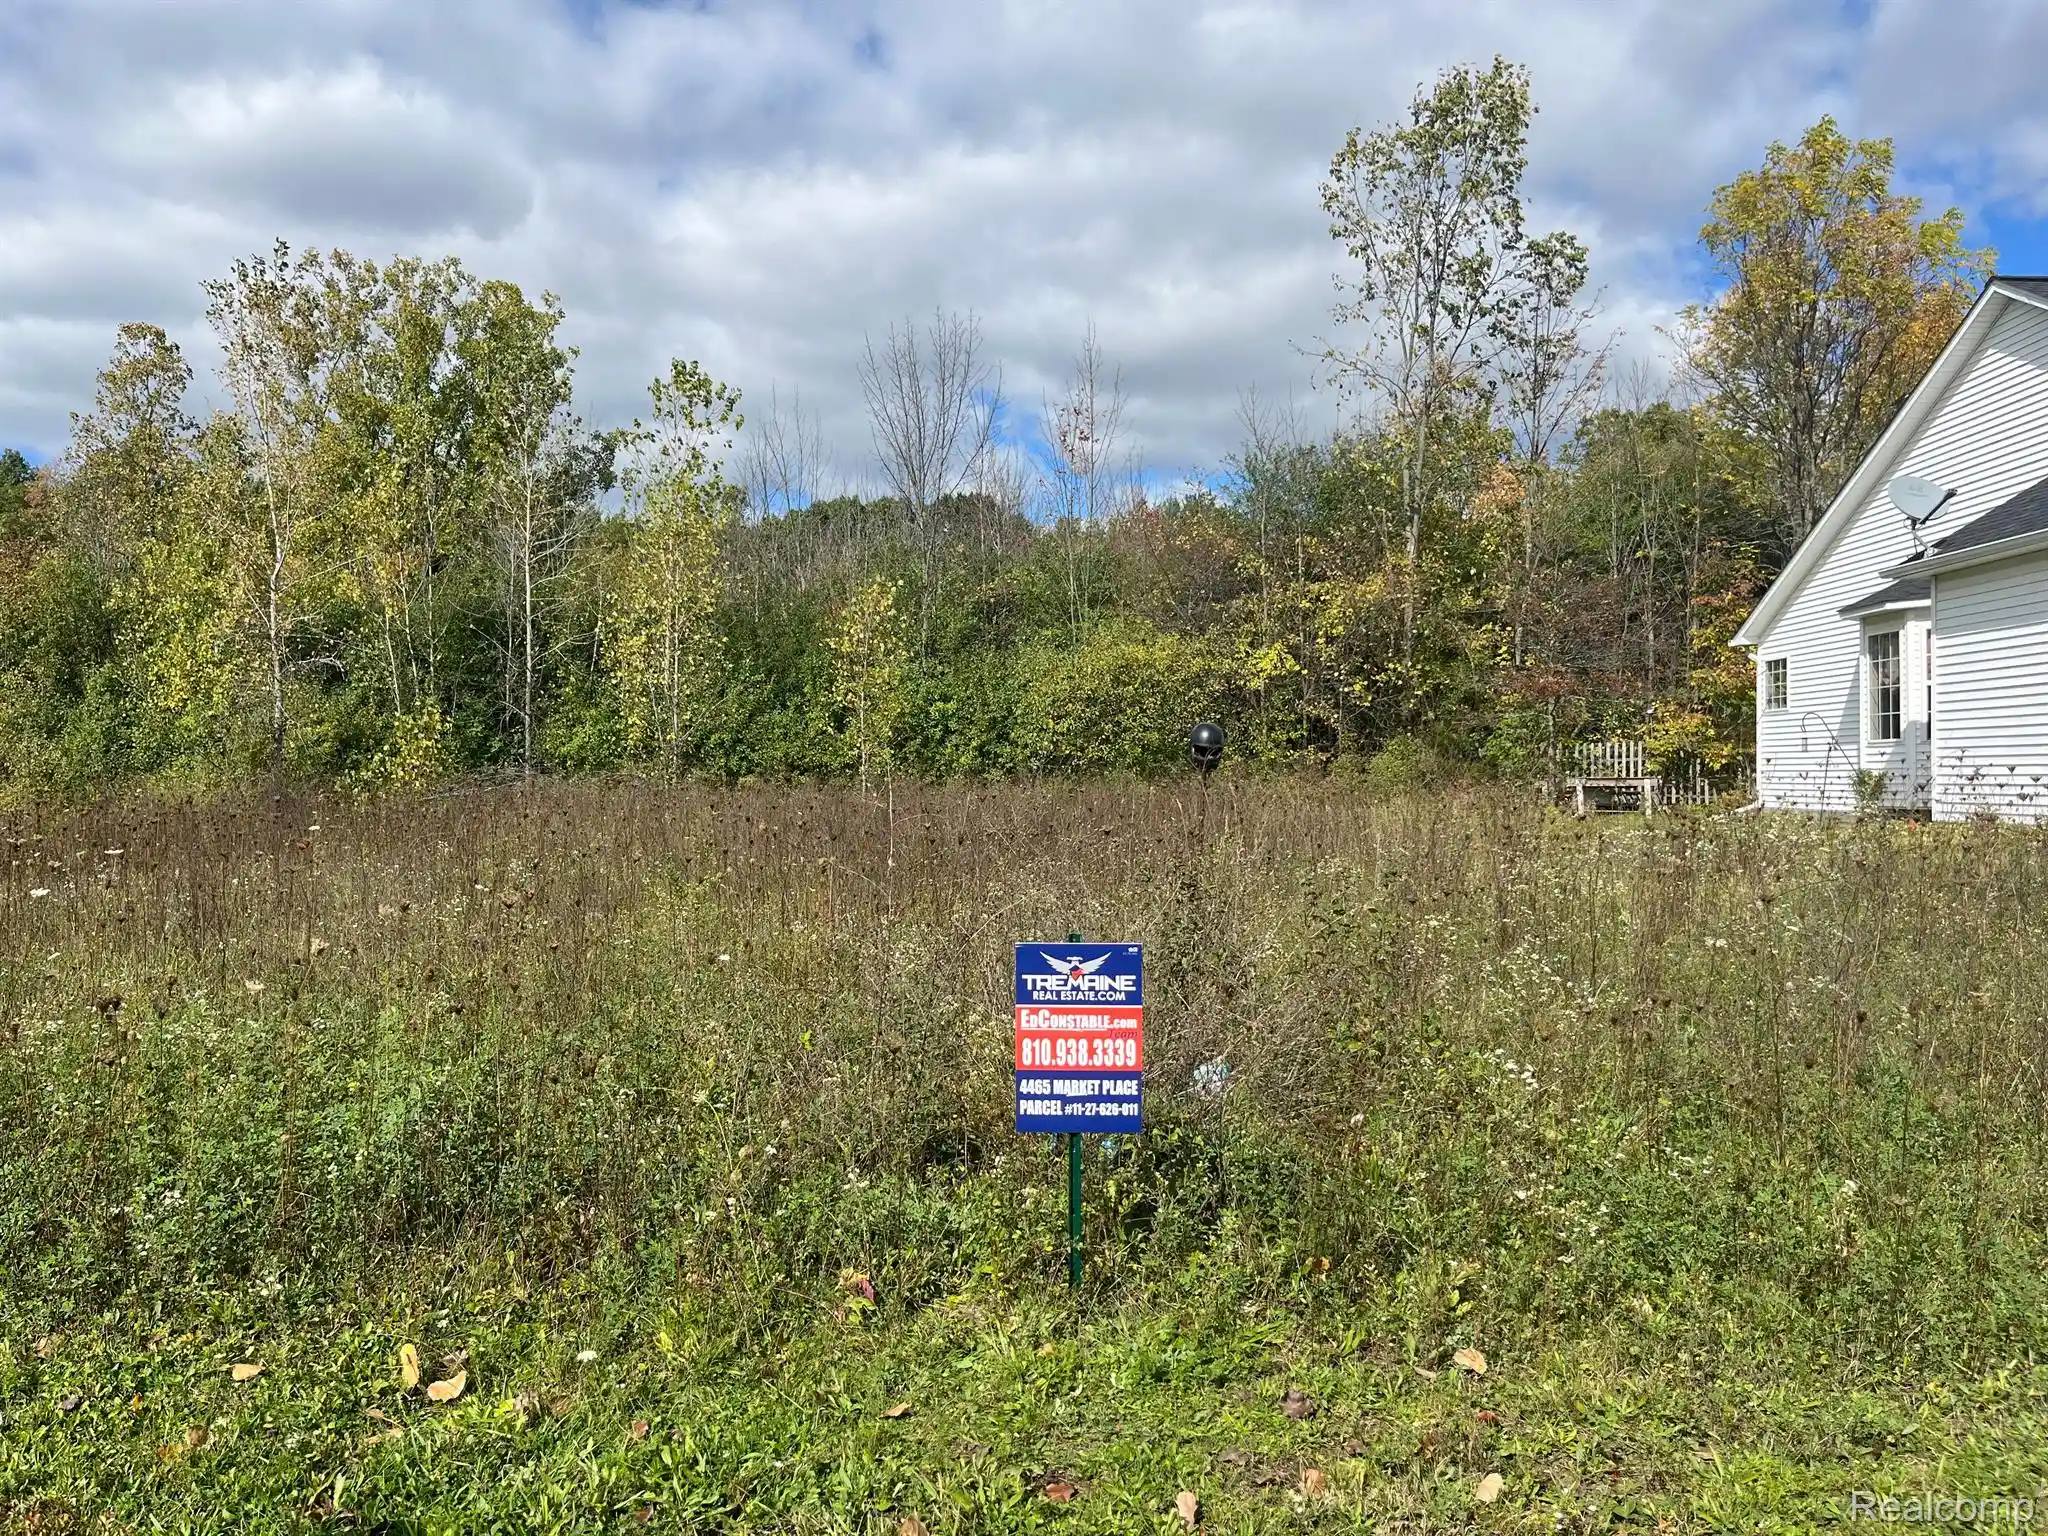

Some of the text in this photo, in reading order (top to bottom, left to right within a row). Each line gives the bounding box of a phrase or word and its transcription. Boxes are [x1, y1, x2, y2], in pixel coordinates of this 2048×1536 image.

[1022, 974, 1137, 991] TREMAINE
[1032, 991, 1126, 1001] REAL ESTATE.COM
[1022, 1038, 1137, 1066] 810.938.3339
[1019, 1079, 1139, 1096] 4465 MARKET PLACE
[1020, 1100, 1139, 1116] PARCEL #11-27-626-011
